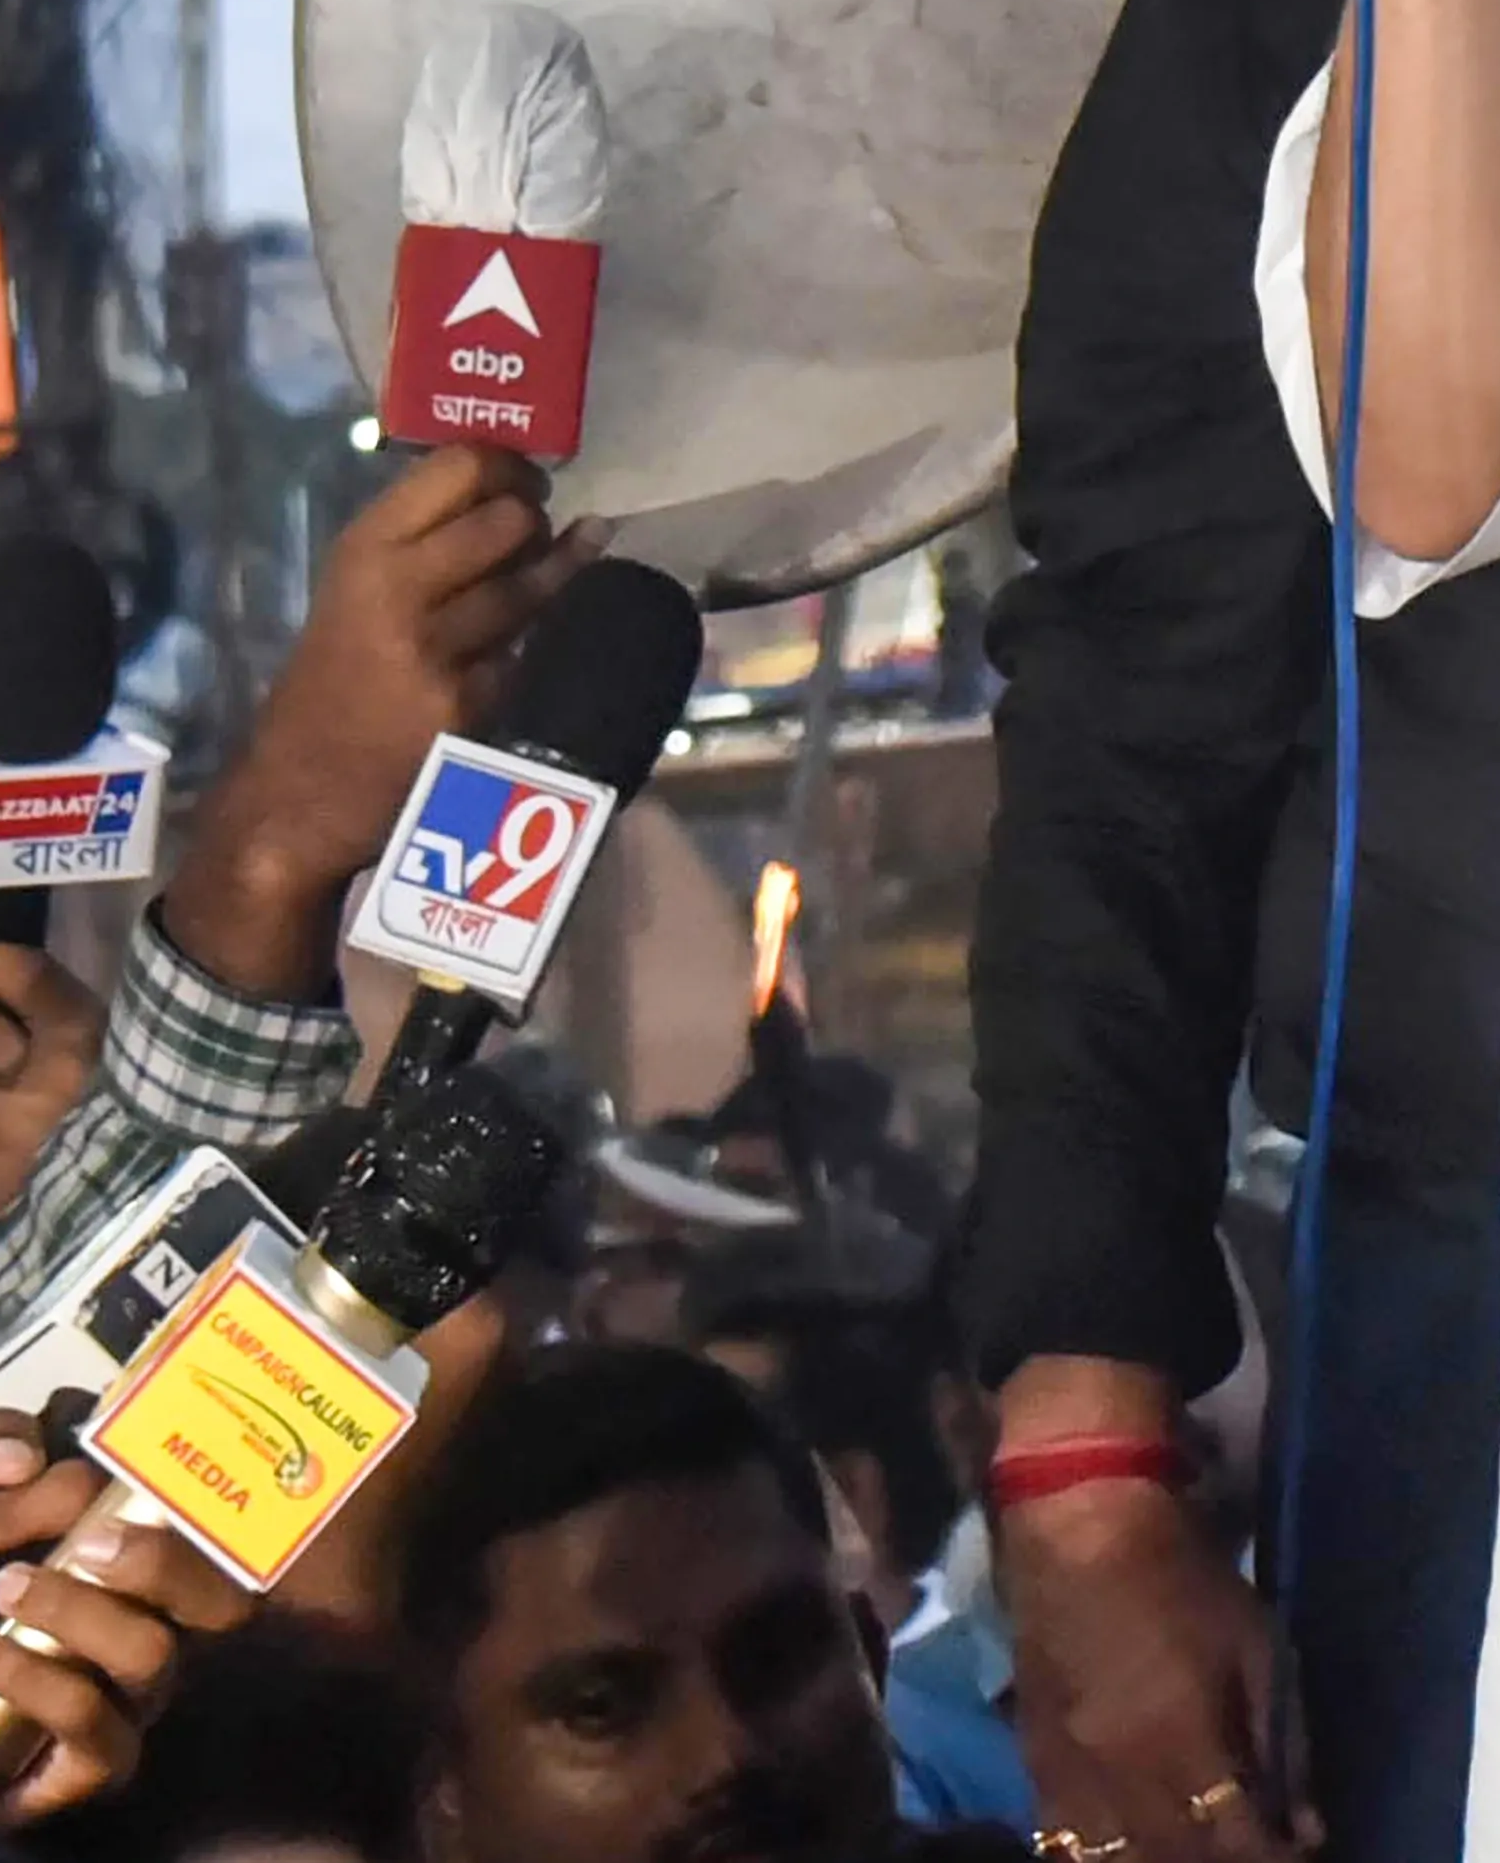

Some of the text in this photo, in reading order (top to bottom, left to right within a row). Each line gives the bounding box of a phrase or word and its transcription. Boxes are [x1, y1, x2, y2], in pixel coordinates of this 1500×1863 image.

[449, 346, 525, 384] abp
[431, 393, 535, 432] আনন্দ
[12, 840, 124, 876] বাংলা
[419, 897, 498, 951] বাংলা
[149, 1255, 185, 1290] N
[161, 1431, 251, 1513] MEDIA
